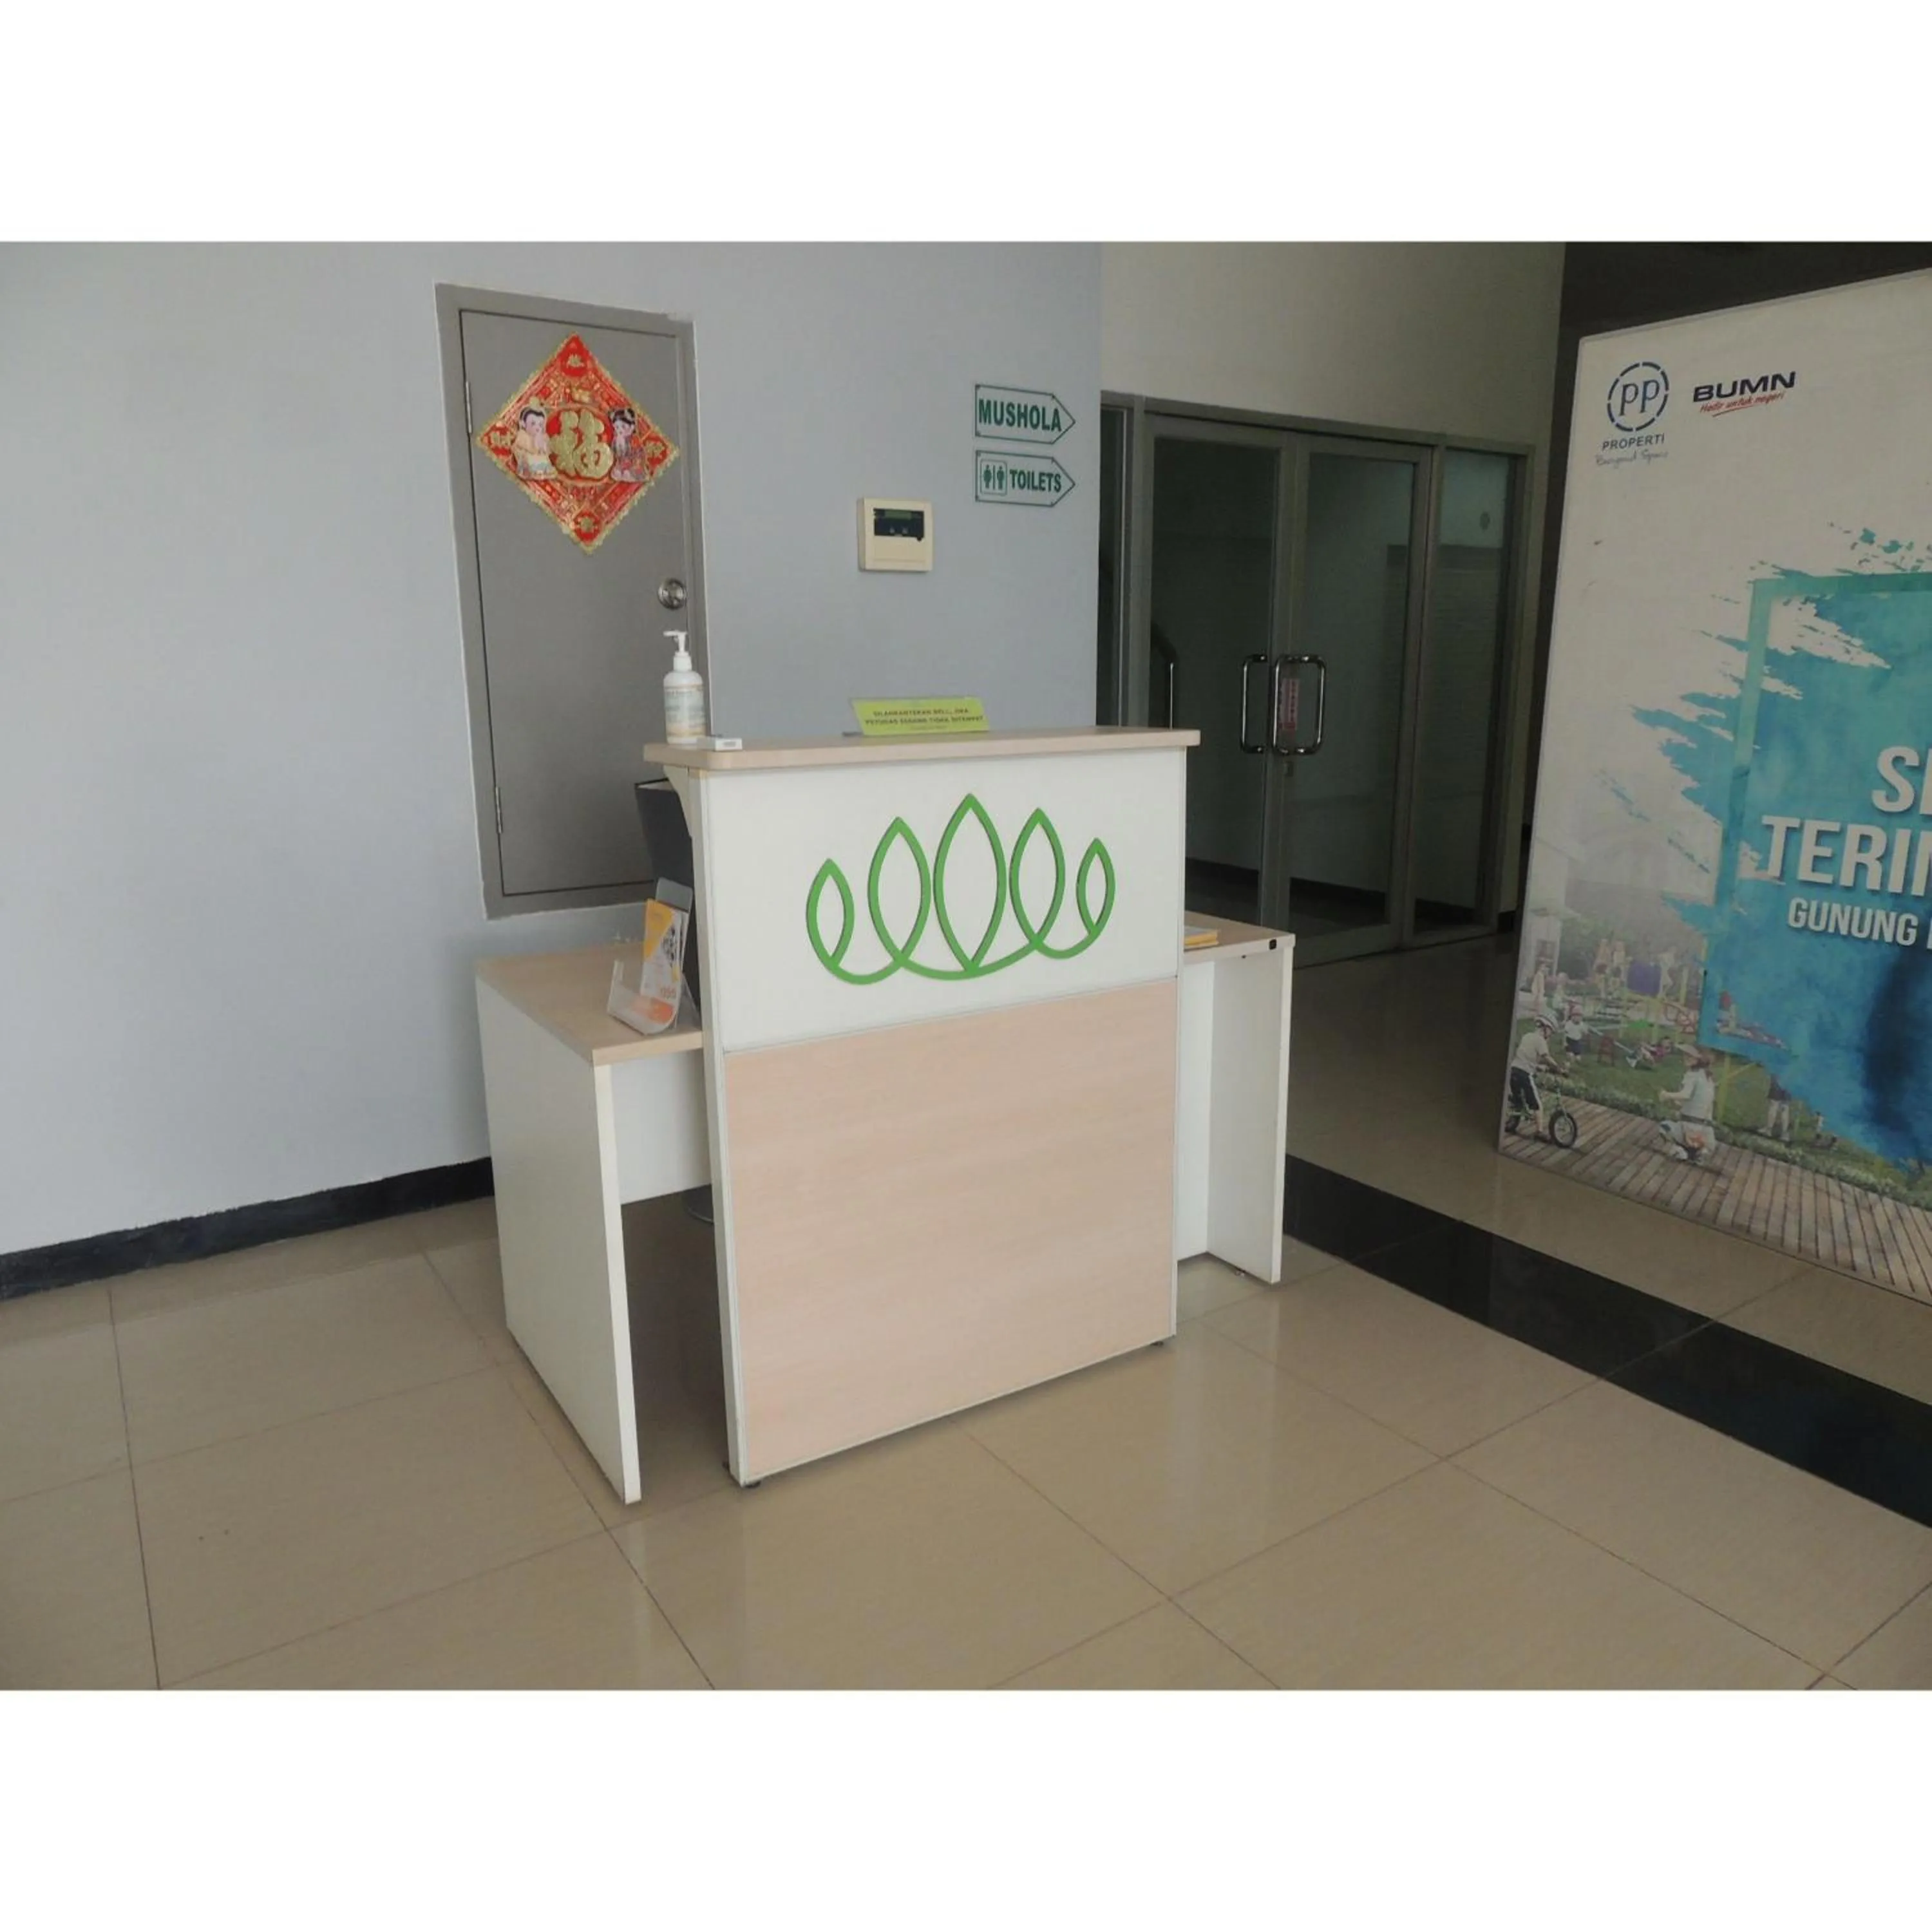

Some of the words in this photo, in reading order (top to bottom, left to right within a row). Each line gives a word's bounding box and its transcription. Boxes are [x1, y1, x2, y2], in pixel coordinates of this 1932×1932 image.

[1692, 371, 1796, 402] BUMN
[978, 399, 1062, 432] MUSHOLA
[1602, 433, 1665, 451] PROPERTI
[1009, 469, 1062, 493] TOILETS
[1788, 896, 1919, 947] GUNUNG
